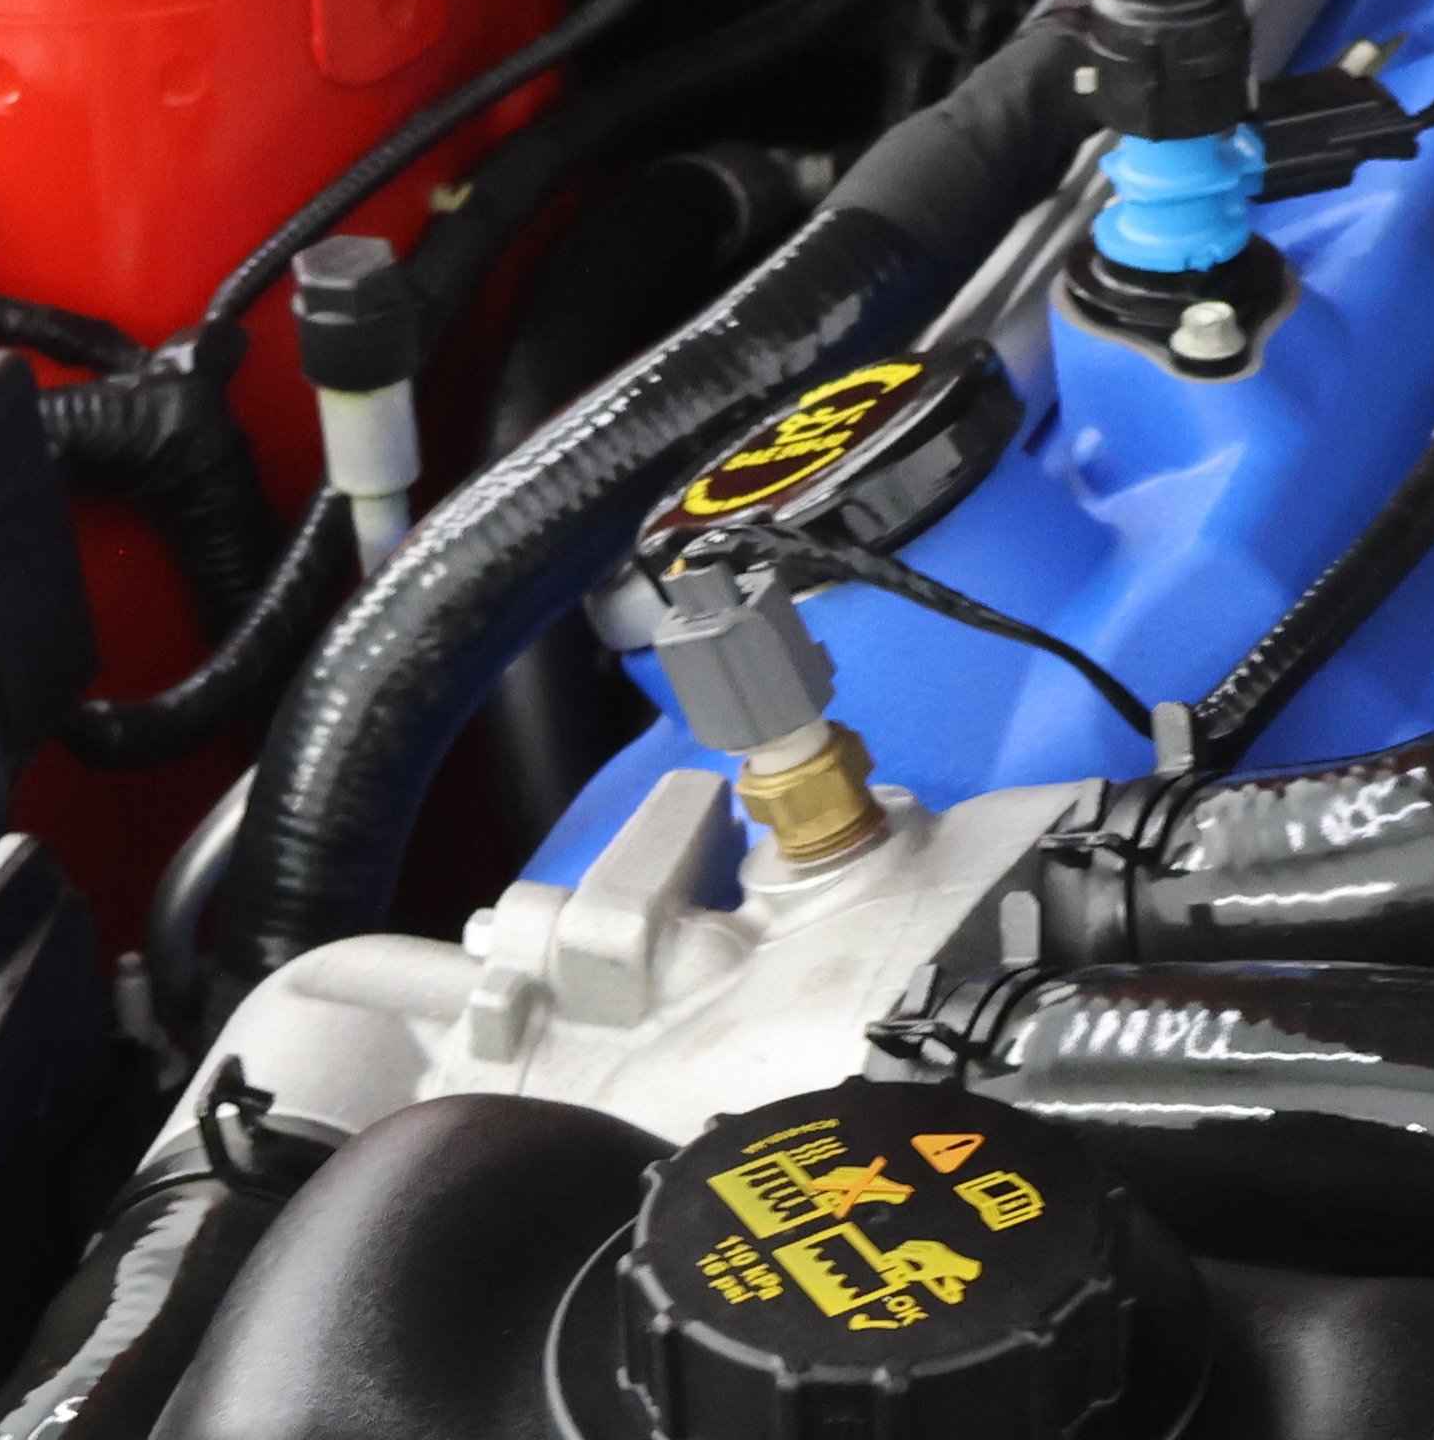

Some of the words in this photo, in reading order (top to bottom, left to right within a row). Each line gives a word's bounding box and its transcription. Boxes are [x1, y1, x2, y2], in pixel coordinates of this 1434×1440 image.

[715, 1235, 761, 1267] 110
[739, 1263, 784, 1301] kPa
[886, 1295, 930, 1327] OK
